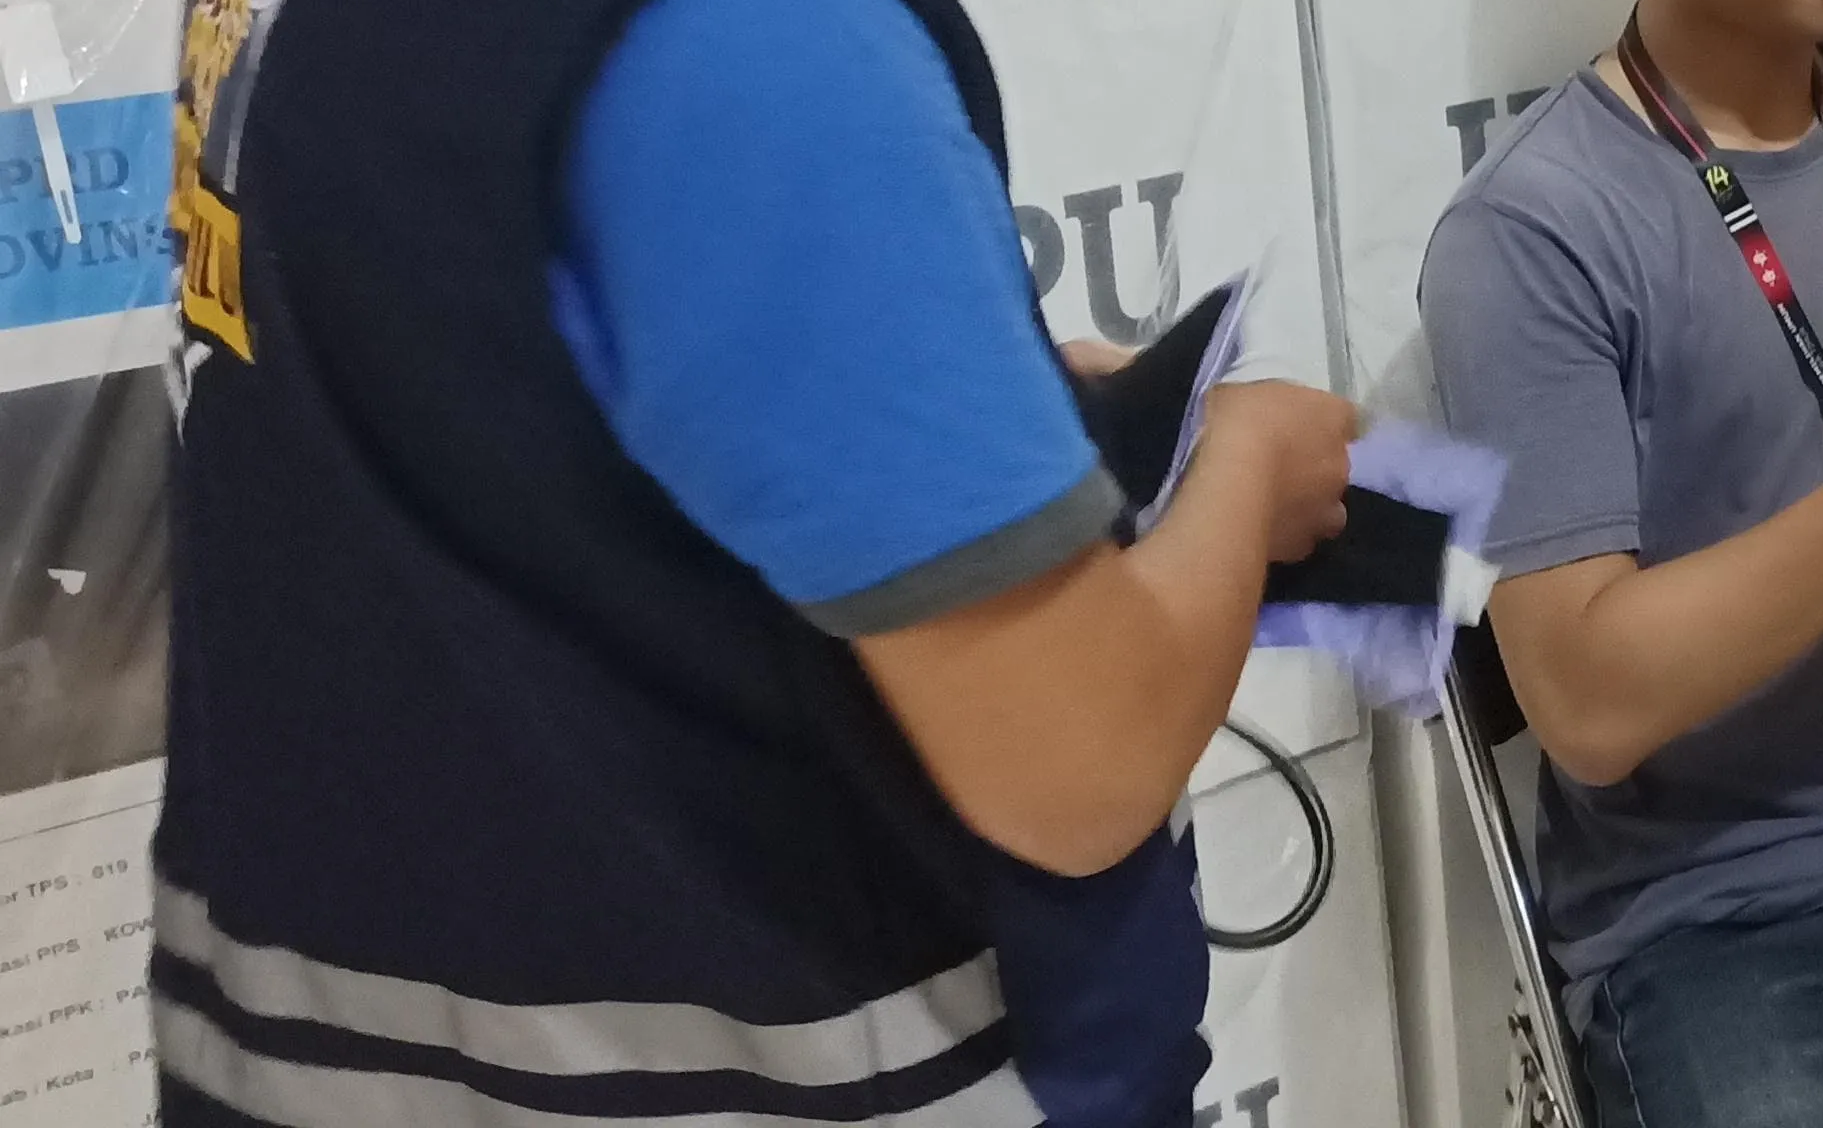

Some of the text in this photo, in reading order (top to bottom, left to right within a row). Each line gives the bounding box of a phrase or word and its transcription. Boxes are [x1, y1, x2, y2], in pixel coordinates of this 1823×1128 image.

[26, 874, 69, 897] TPS
[37, 938, 81, 961] PPS
[49, 1000, 93, 1024] PPK
